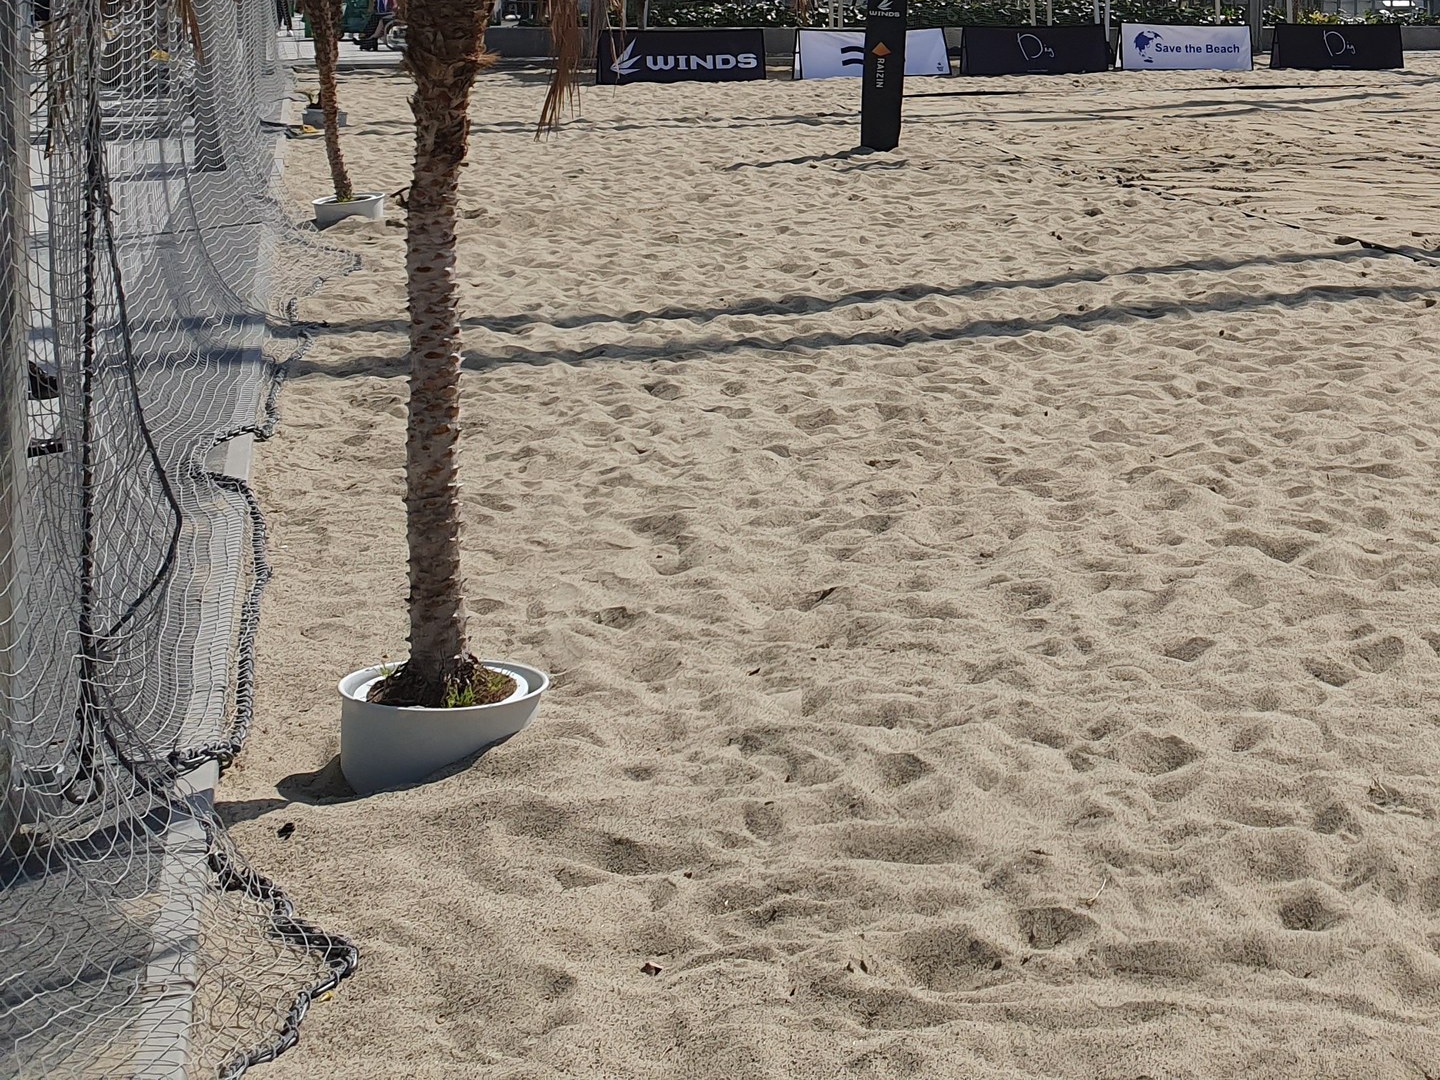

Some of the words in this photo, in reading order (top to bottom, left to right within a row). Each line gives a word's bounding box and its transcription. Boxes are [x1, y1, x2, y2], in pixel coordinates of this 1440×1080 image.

[1155, 42, 1182, 53] Save
[1185, 44, 1202, 53] the
[1206, 43, 1240, 54] Beach
[646, 53, 758, 71] WINDS
[875, 58, 885, 88] RAIZIN
